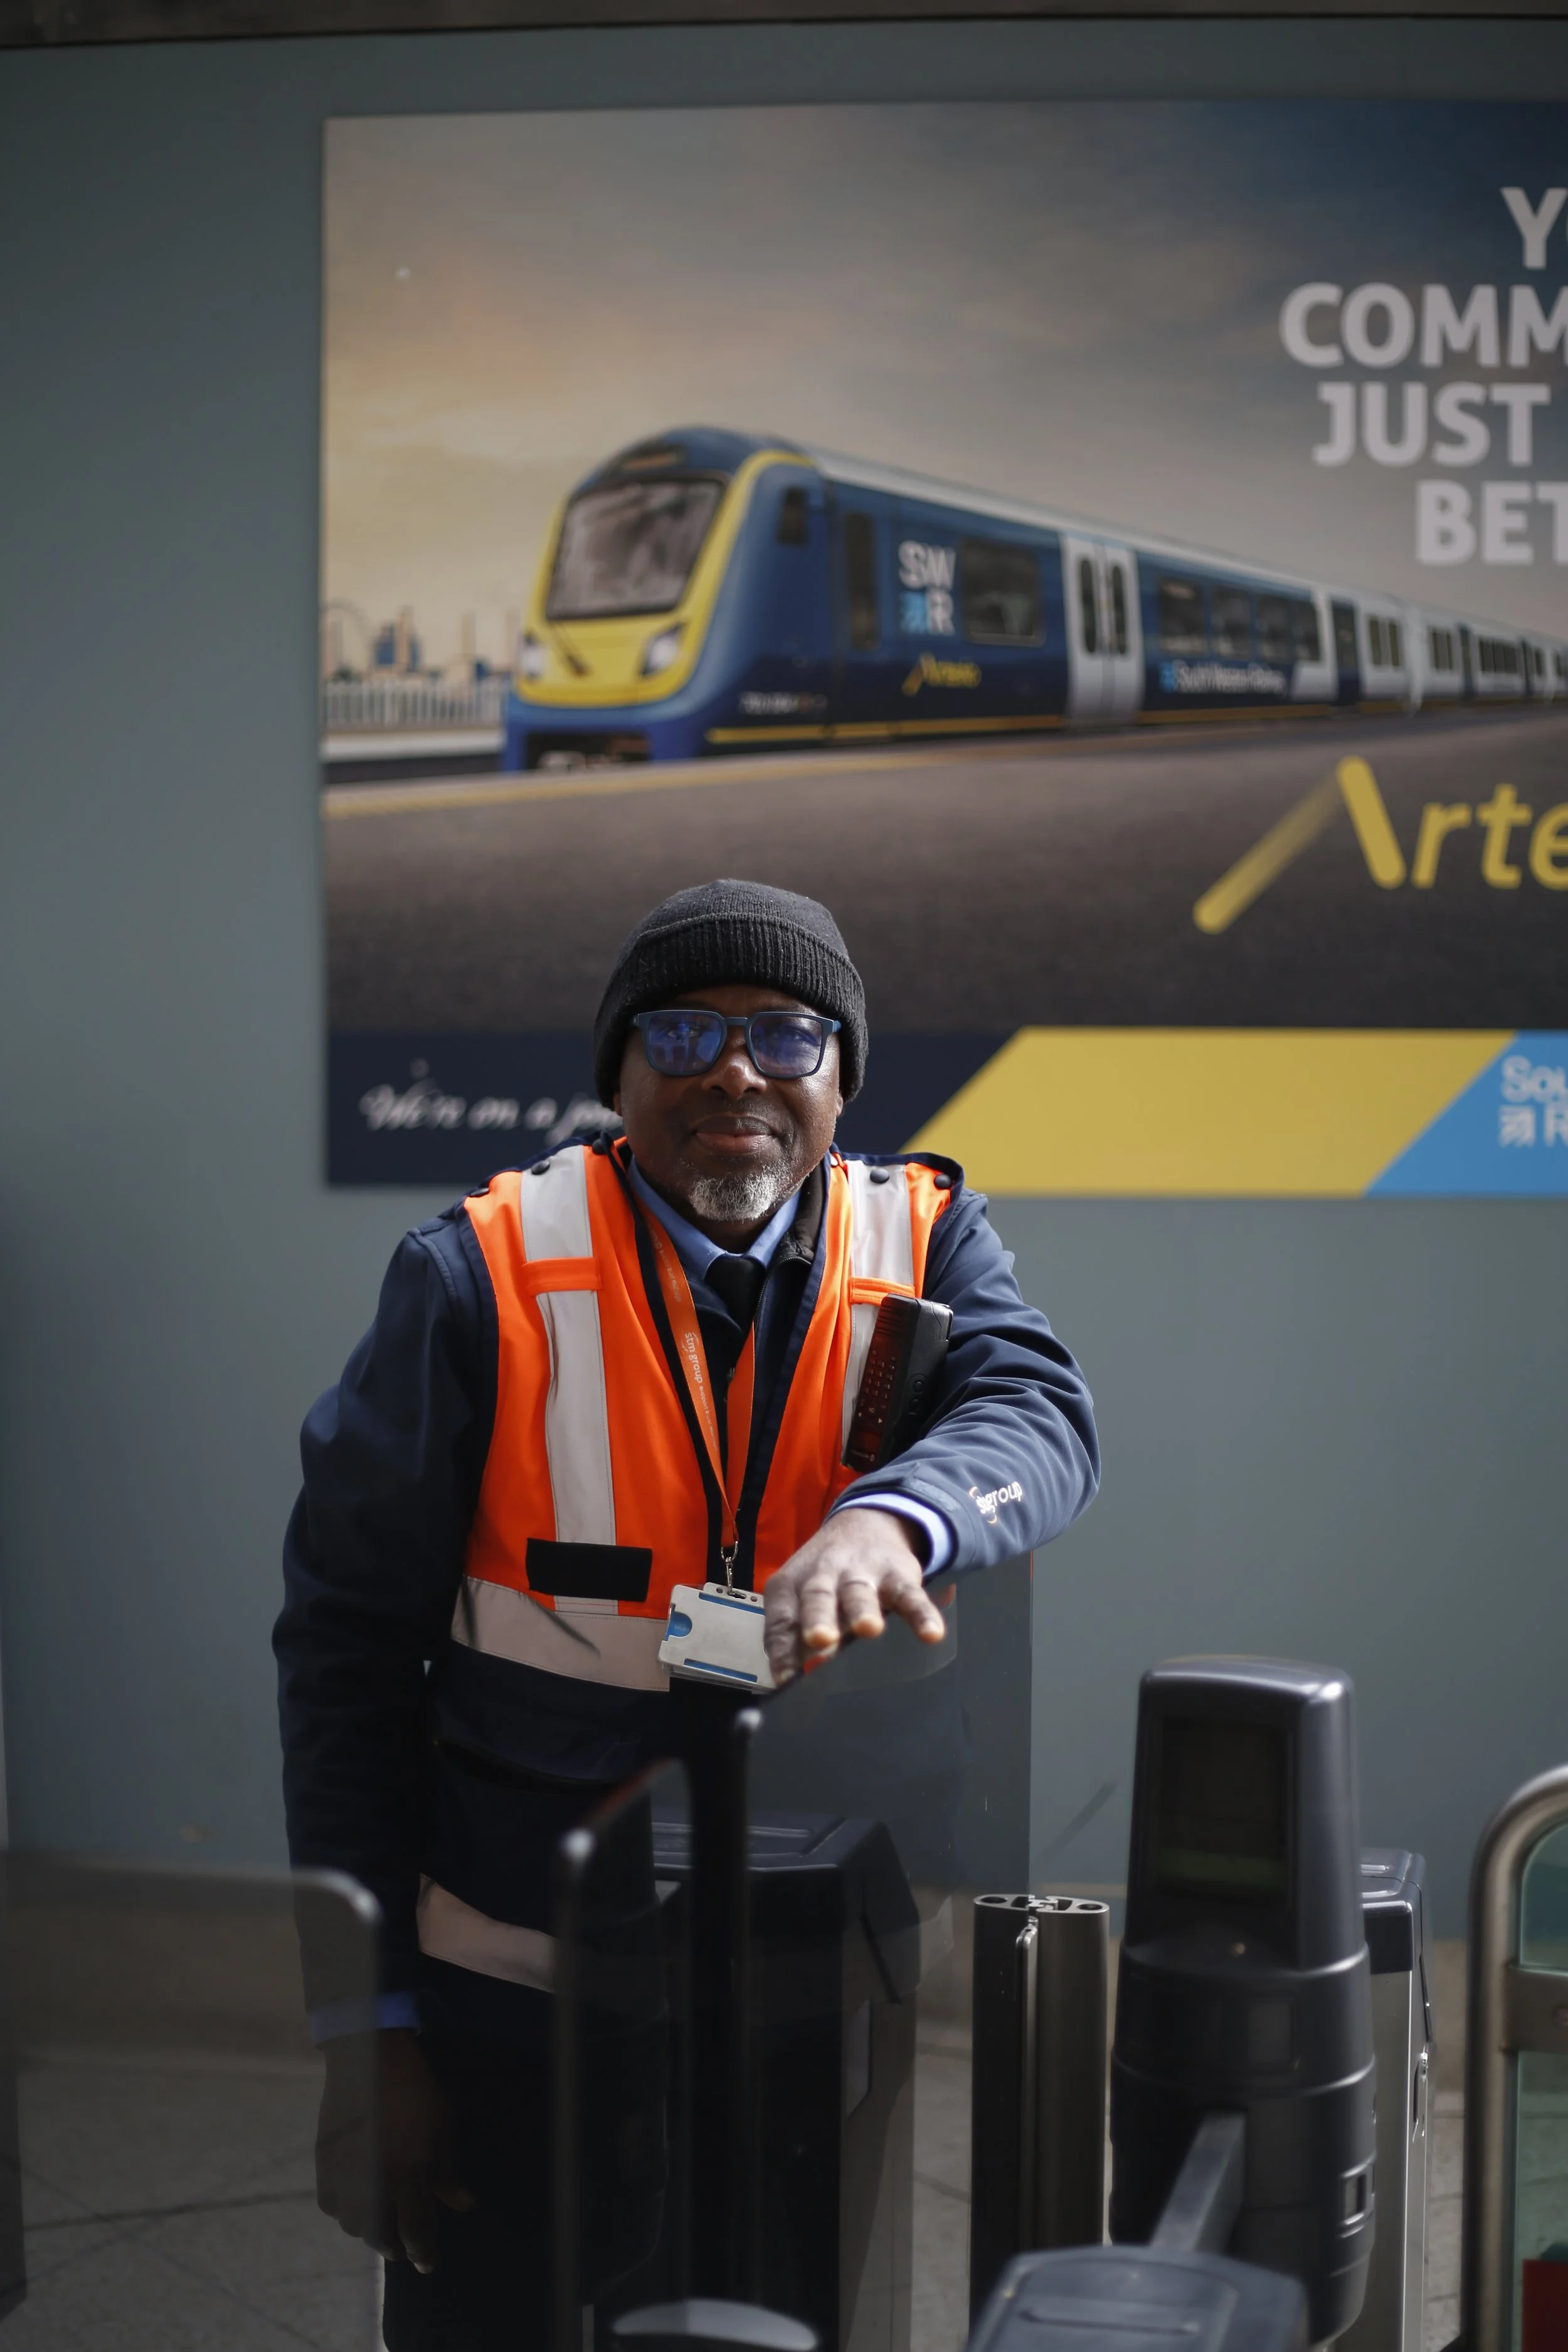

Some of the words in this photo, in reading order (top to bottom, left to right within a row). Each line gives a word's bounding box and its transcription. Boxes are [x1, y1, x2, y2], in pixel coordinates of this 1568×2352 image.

[1500, 186, 1568, 270] Y
[1279, 282, 1568, 369] COMM
[1312, 381, 1551, 467] JUST
[898, 540, 956, 591] SW
[467, 1096, 519, 1129] on
[689, 1354, 702, 1383] group
